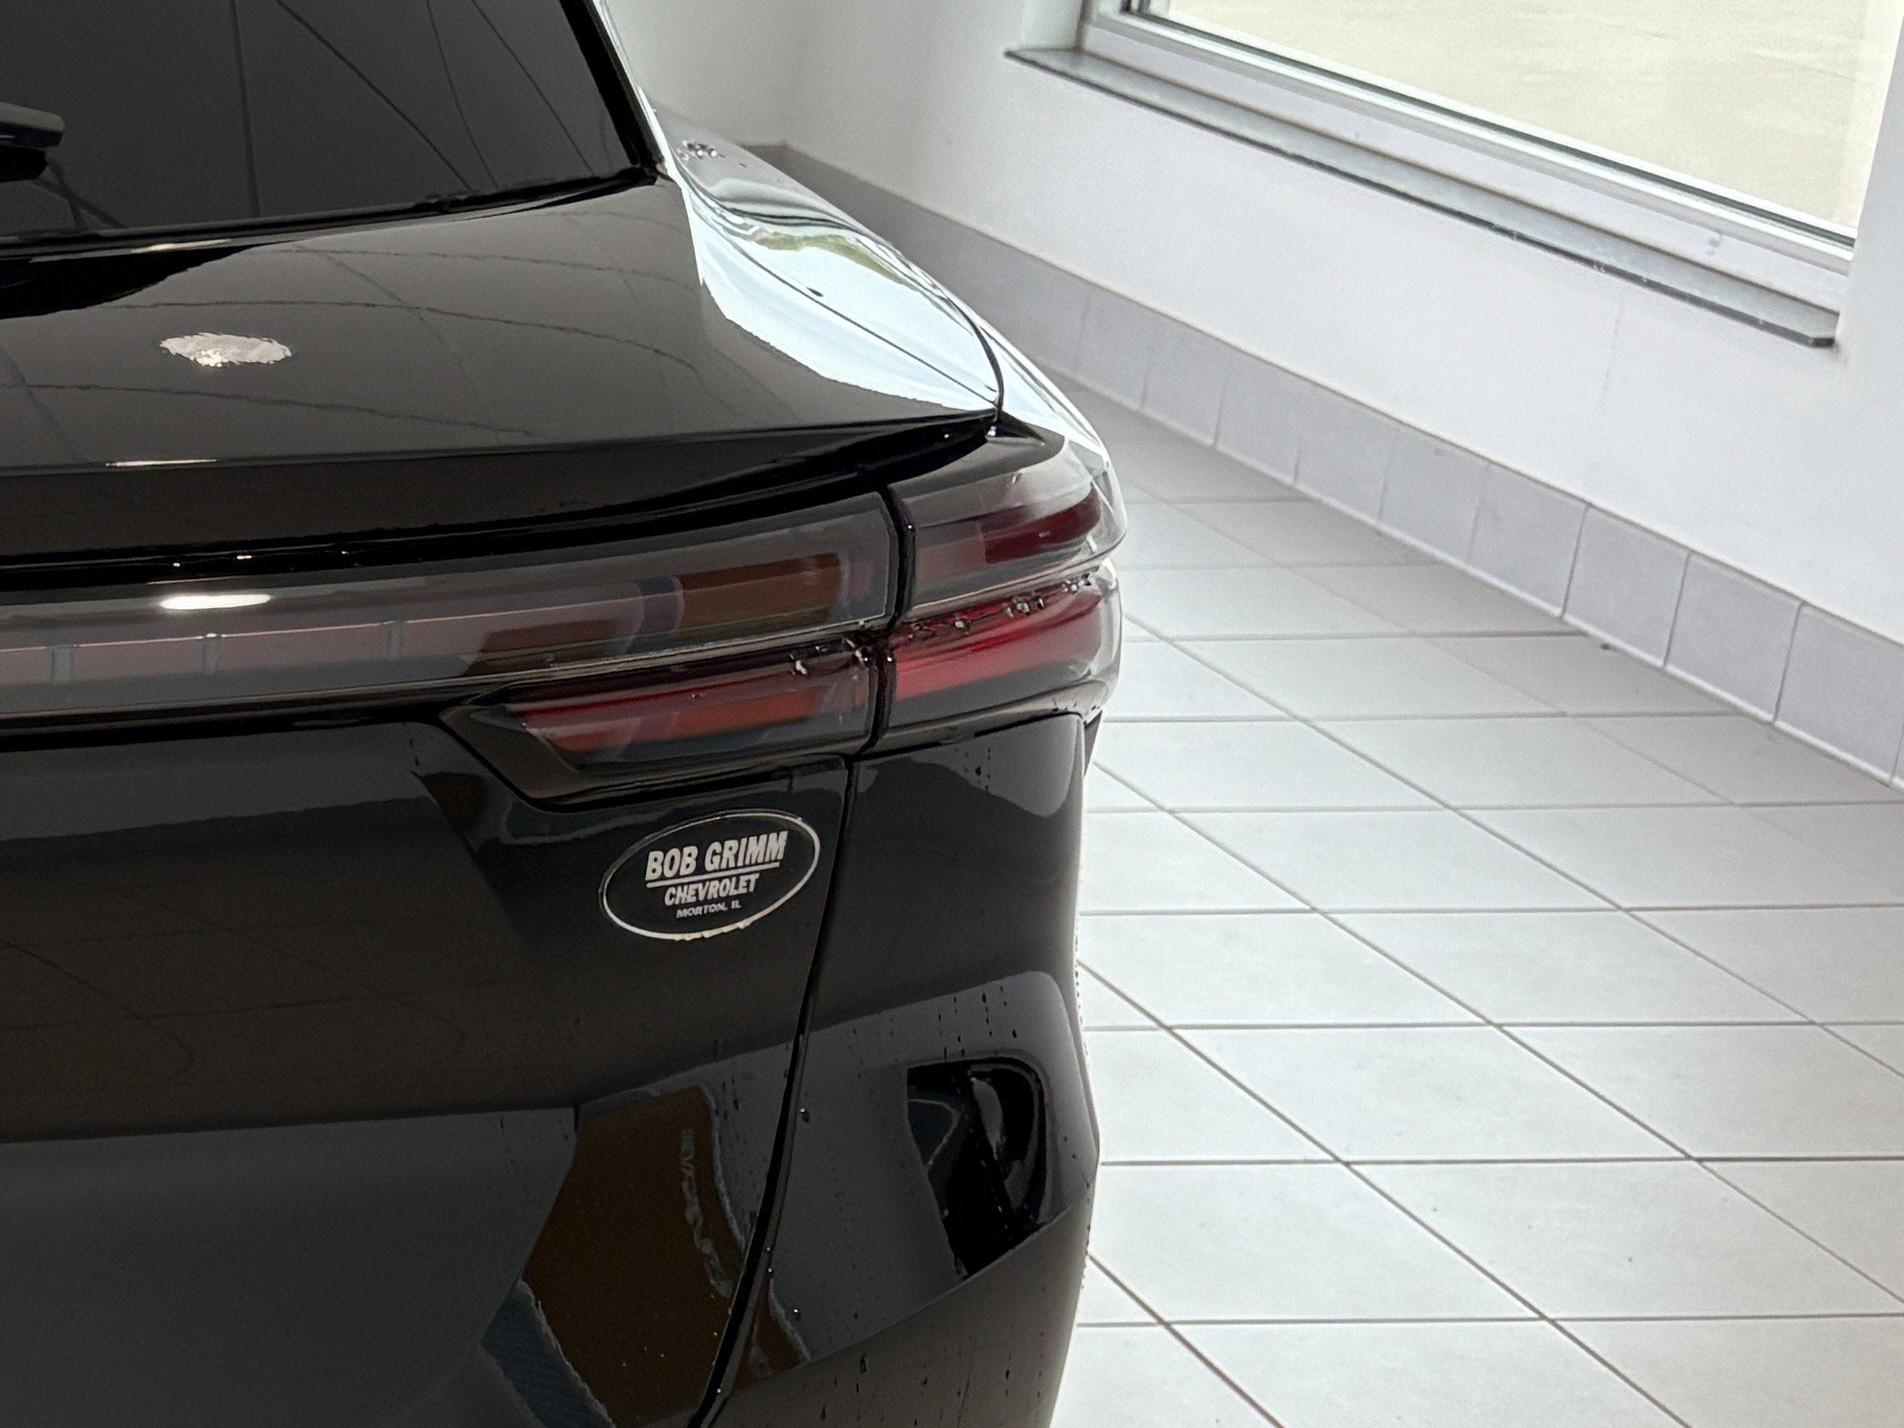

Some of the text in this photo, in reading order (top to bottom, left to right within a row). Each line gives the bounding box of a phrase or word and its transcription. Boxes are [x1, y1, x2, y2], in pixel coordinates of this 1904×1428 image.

[645, 831, 787, 881] BOB GRIMM
[664, 873, 759, 905] CHEVROLET
